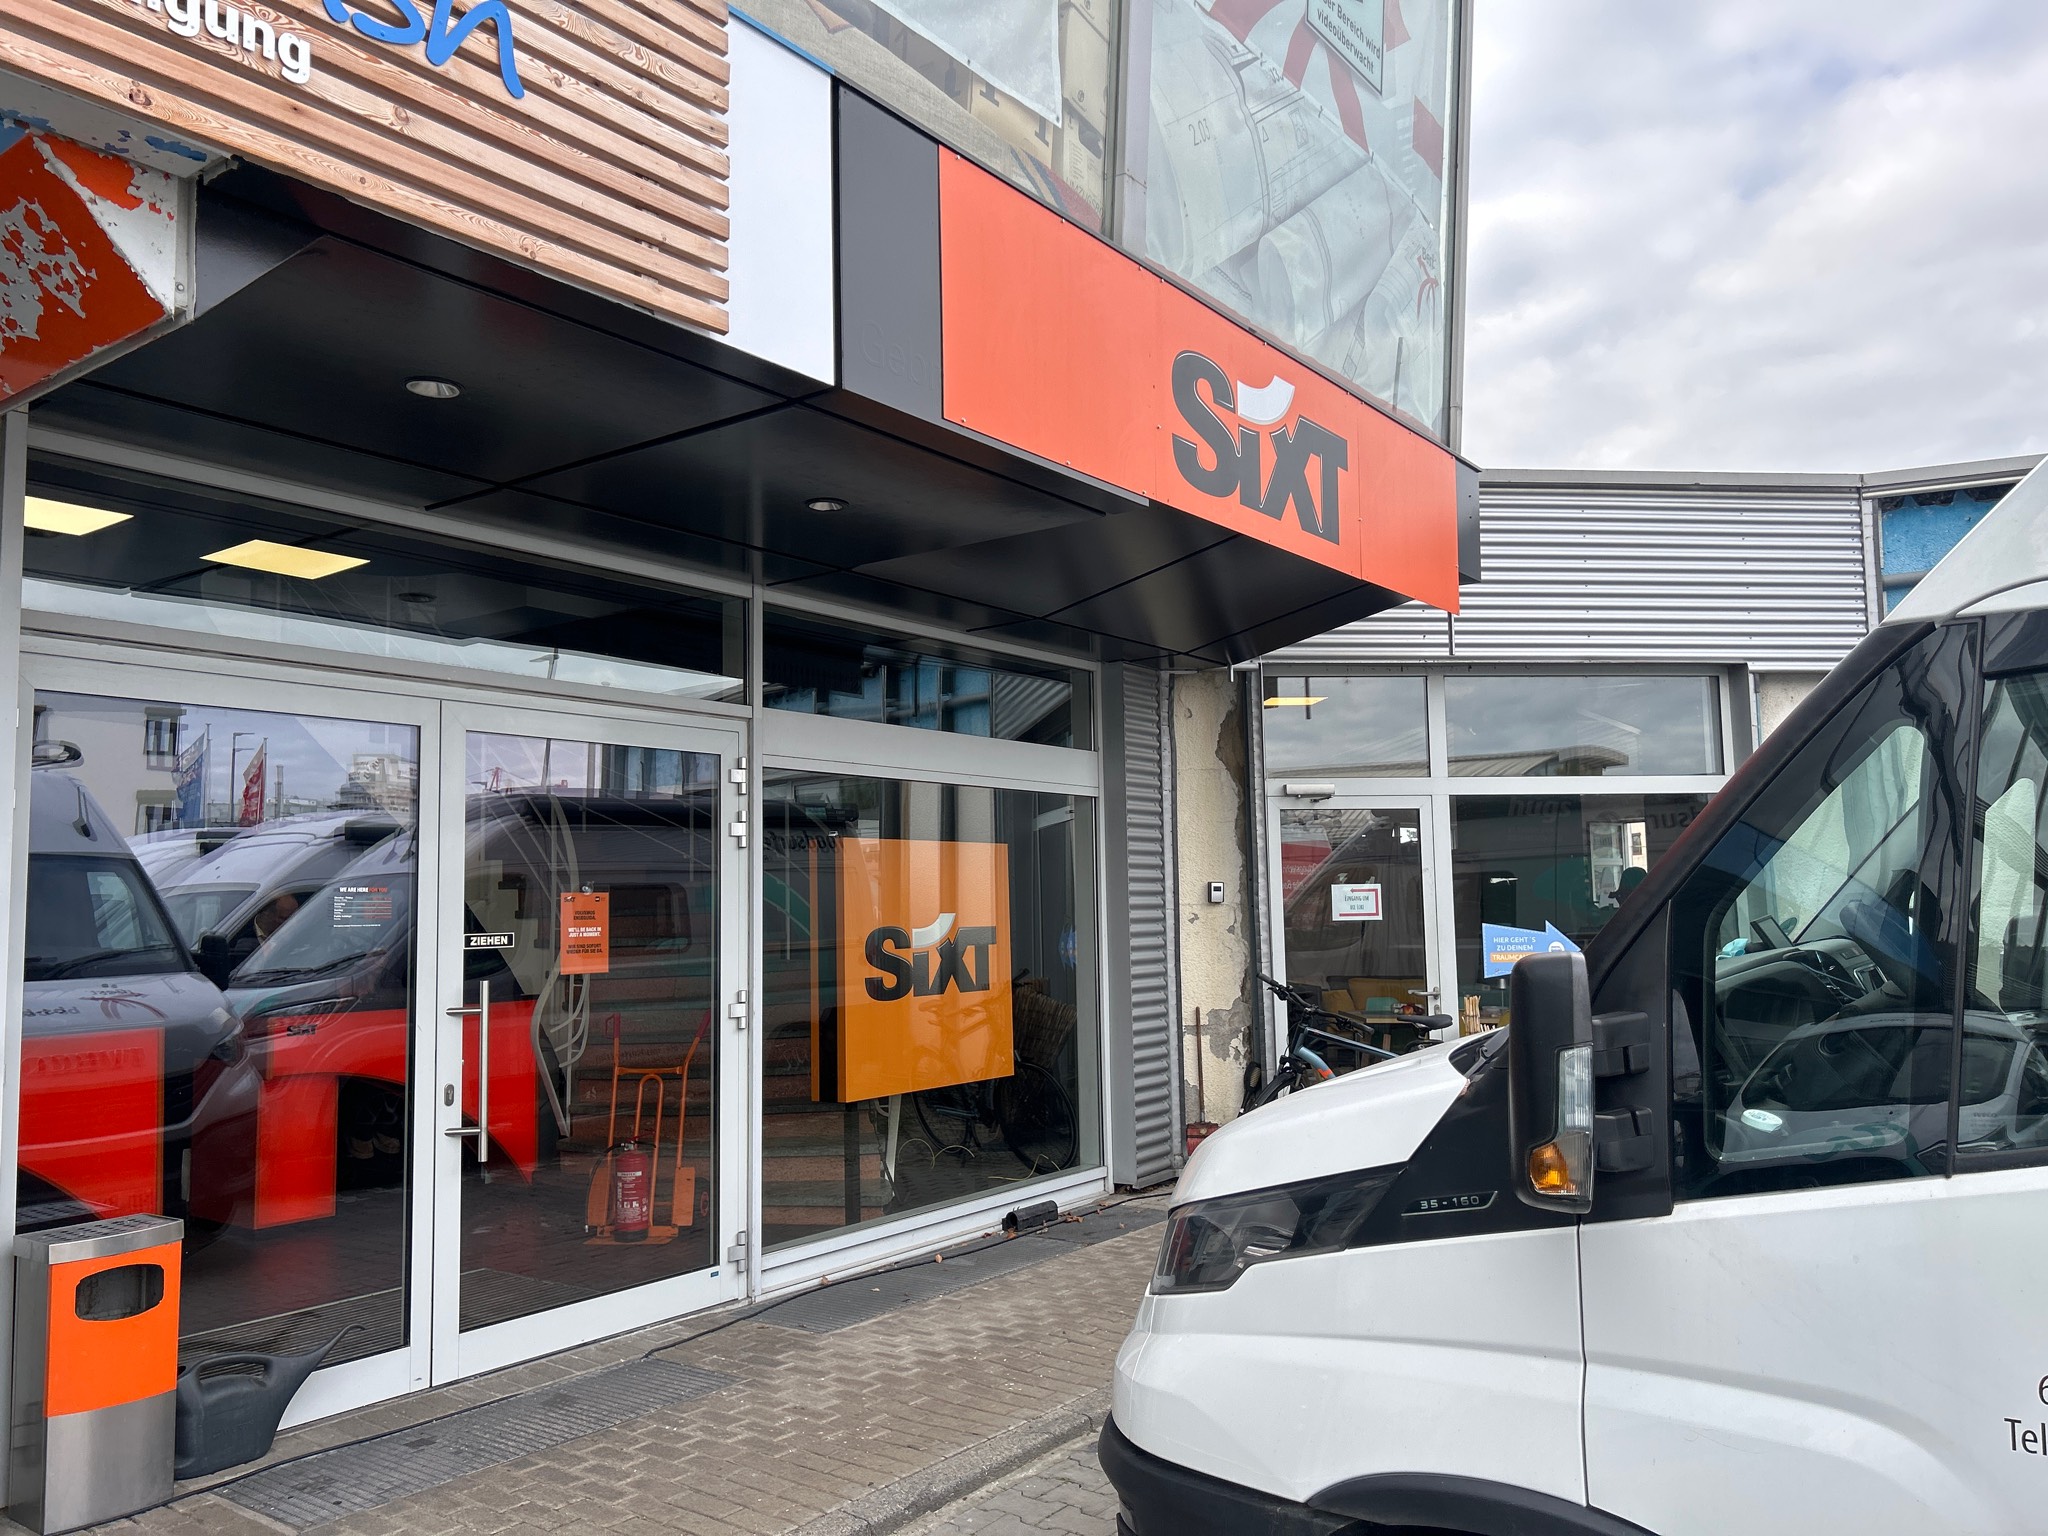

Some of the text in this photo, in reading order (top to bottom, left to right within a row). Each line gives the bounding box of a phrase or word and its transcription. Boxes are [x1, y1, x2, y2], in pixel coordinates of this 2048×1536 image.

[1317, 8, 1374, 74] videoüberwacht
[1337, 4, 1364, 42] Bereich
[1365, 37, 1381, 60] wird
[1172, 350, 1348, 545] SIXT
[470, 936, 508, 946] ZIEHEN
[865, 913, 996, 1001] SIXT
[1492, 953, 1528, 961] TRAUMCA
